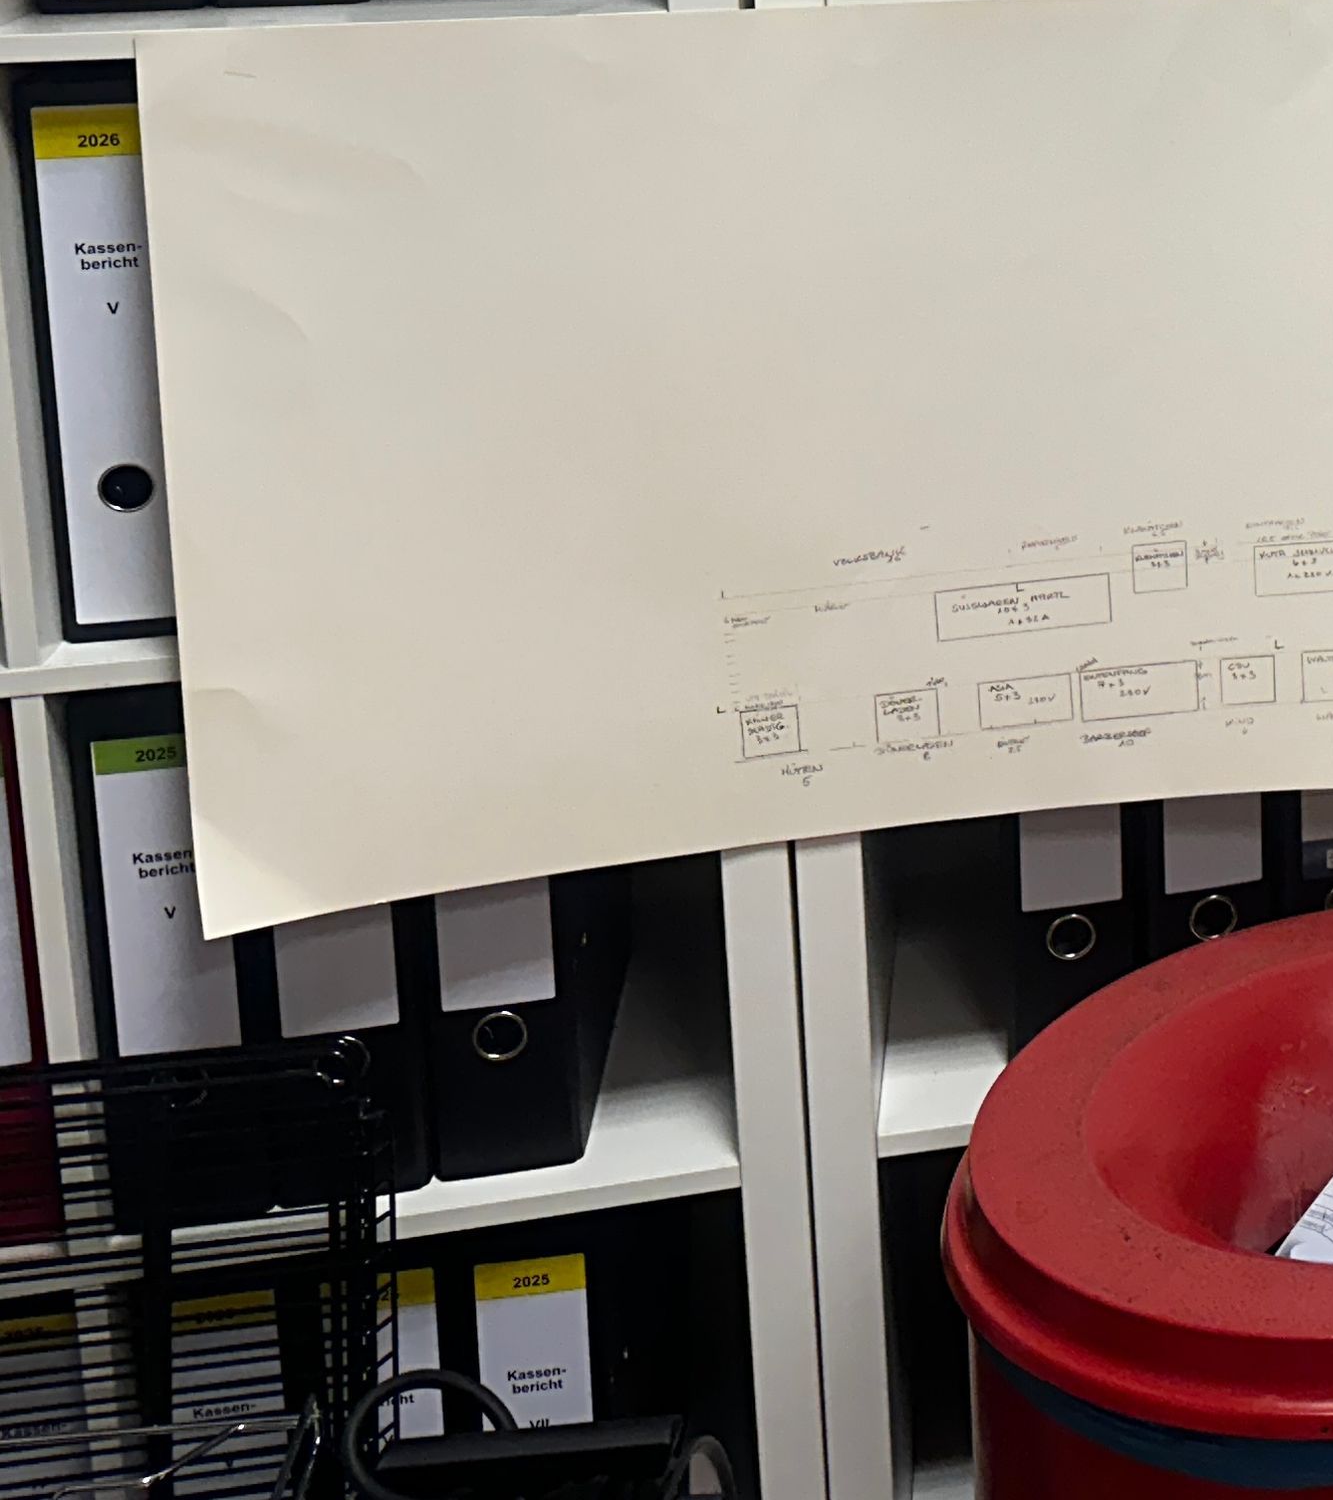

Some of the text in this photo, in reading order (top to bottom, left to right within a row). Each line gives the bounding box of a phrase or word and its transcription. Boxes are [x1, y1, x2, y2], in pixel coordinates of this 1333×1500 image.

[77, 133, 121, 148] 2026
[74, 242, 143, 256] Kassen-
[80, 256, 139, 270] bericht
[107, 302, 119, 315] V
[135, 746, 177, 763] 2025
[132, 849, 193, 865] Kassen
[138, 862, 195, 879] bericht
[164, 906, 176, 919] V
[513, 1274, 550, 1288] 2025
[507, 1367, 567, 1381] Kassen-
[512, 1379, 563, 1394] bericht
